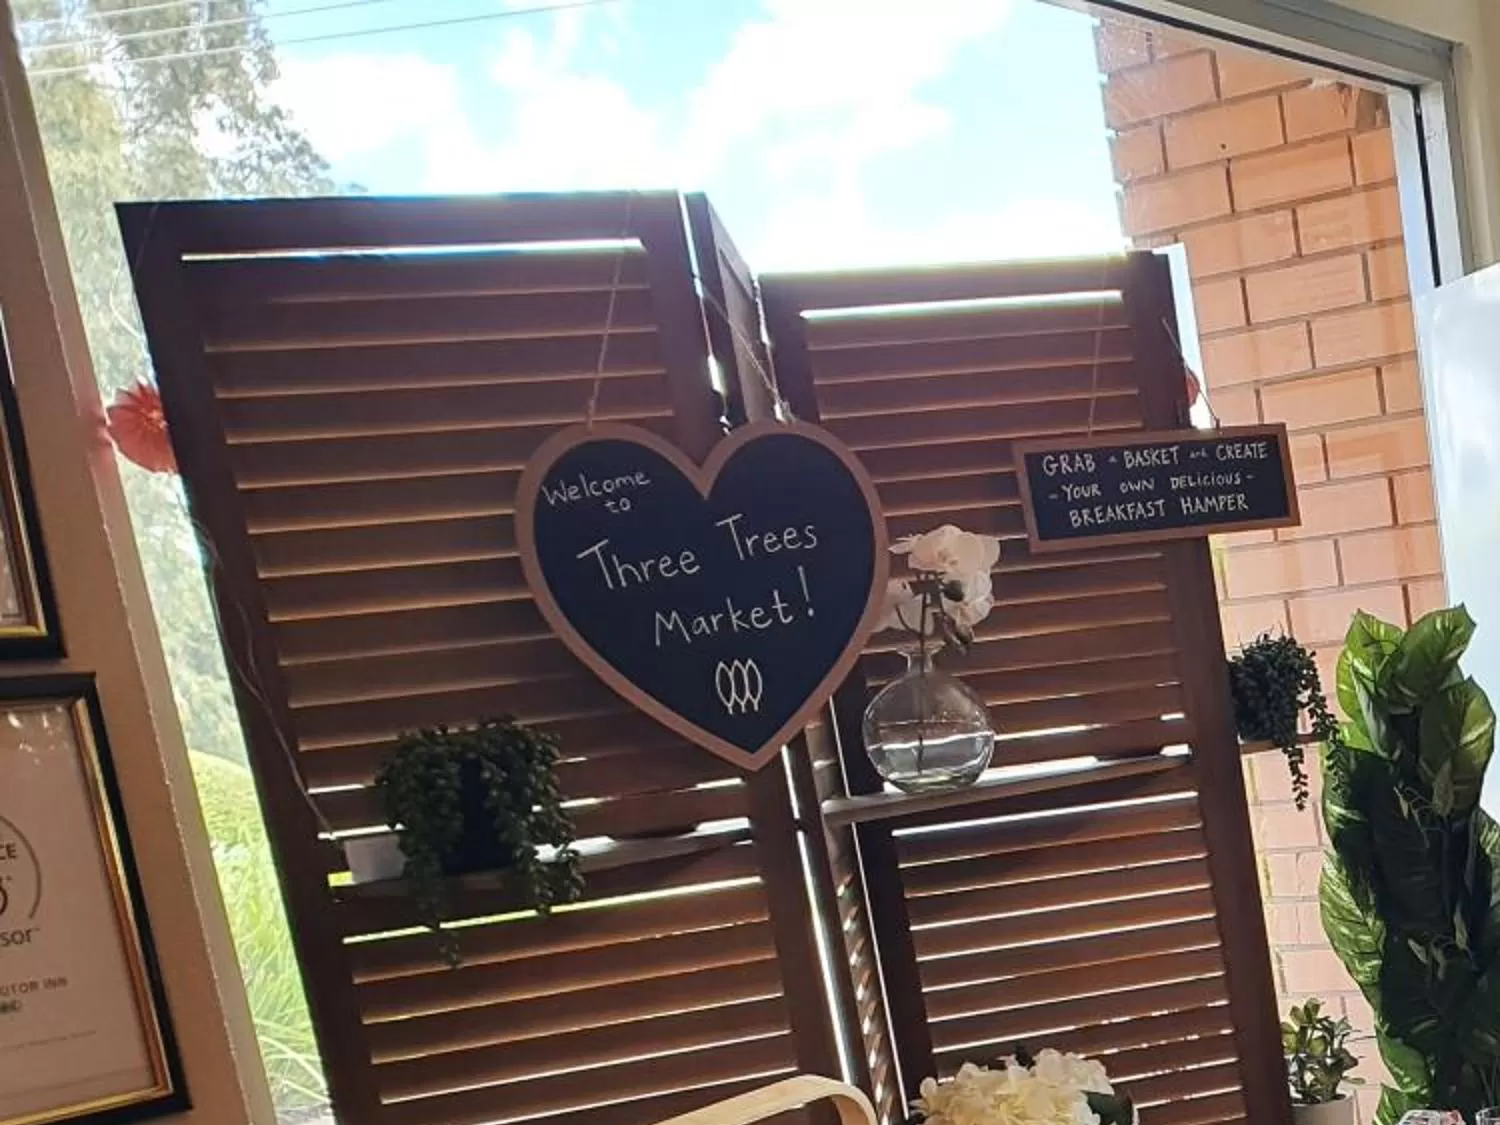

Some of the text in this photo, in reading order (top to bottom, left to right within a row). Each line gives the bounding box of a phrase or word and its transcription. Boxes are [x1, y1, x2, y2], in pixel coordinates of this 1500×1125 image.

[1042, 454, 1096, 476] GRAB
[1123, 446, 1181, 468] BASKET
[1216, 441, 1268, 461] CREATE
[542, 469, 652, 506] Welcome
[604, 497, 631, 513] to
[1062, 473, 1241, 502] YOUR OWN DELICIOUS
[1069, 493, 1249, 528] BREAKFAST HAMPER
[576, 512, 818, 590] Three Trees
